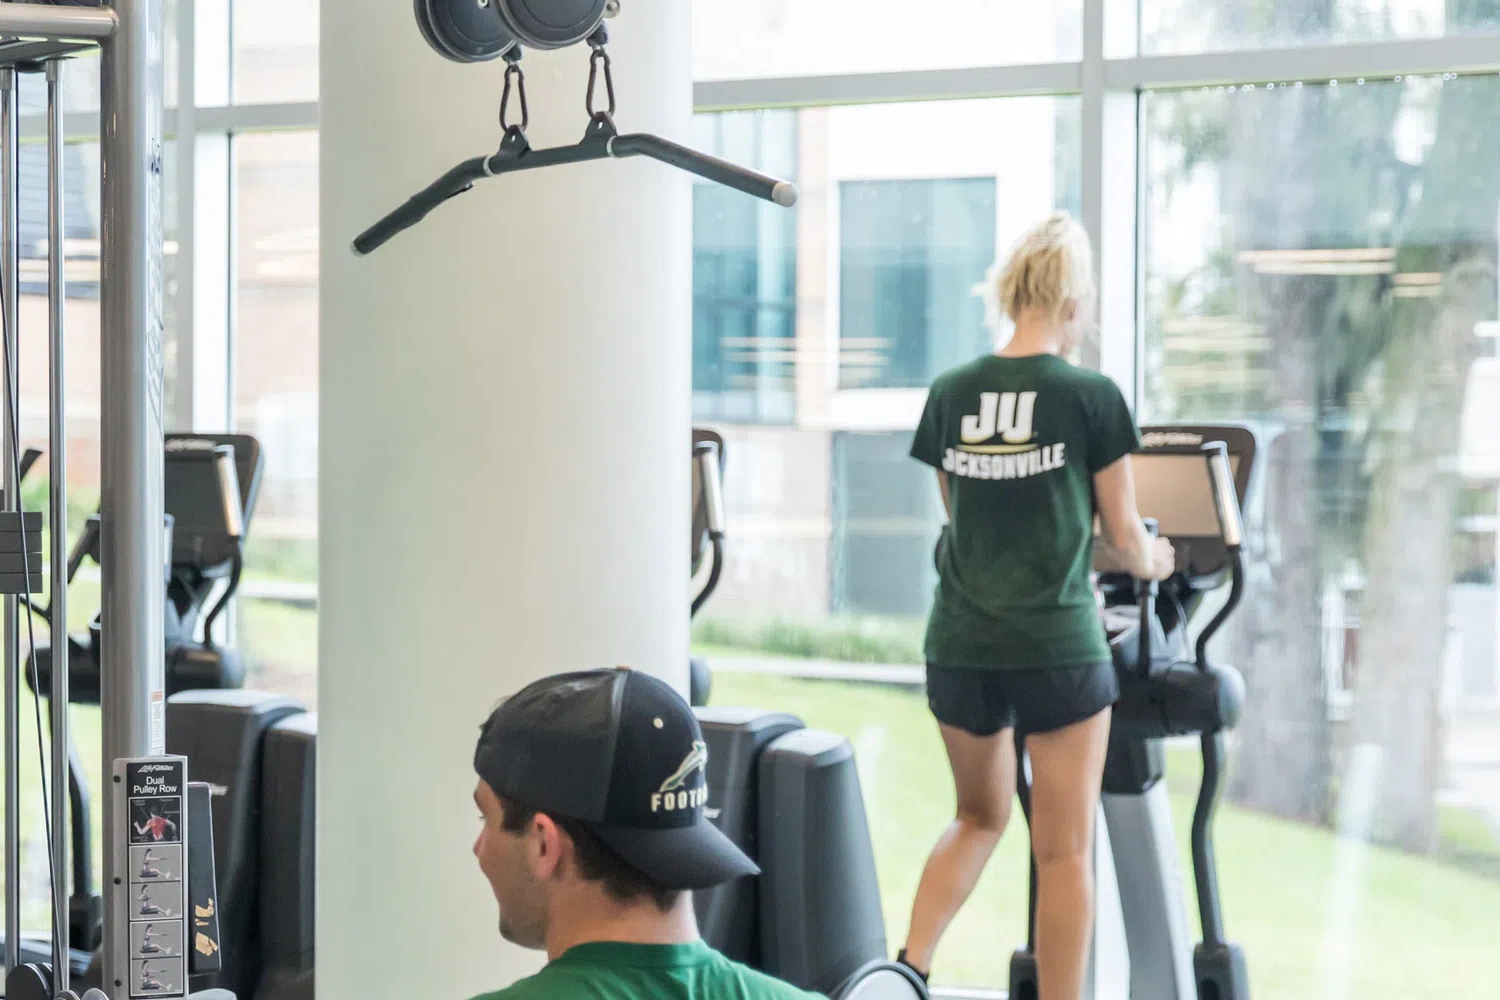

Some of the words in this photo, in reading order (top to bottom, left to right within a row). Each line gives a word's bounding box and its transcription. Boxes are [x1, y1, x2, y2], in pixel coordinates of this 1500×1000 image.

[960, 390, 1038, 445] JU
[941, 442, 1066, 481] JCKSONVILLE
[133, 785, 158, 795] Pulley
[159, 784, 177, 793] Row
[146, 776, 165, 785] Dual
